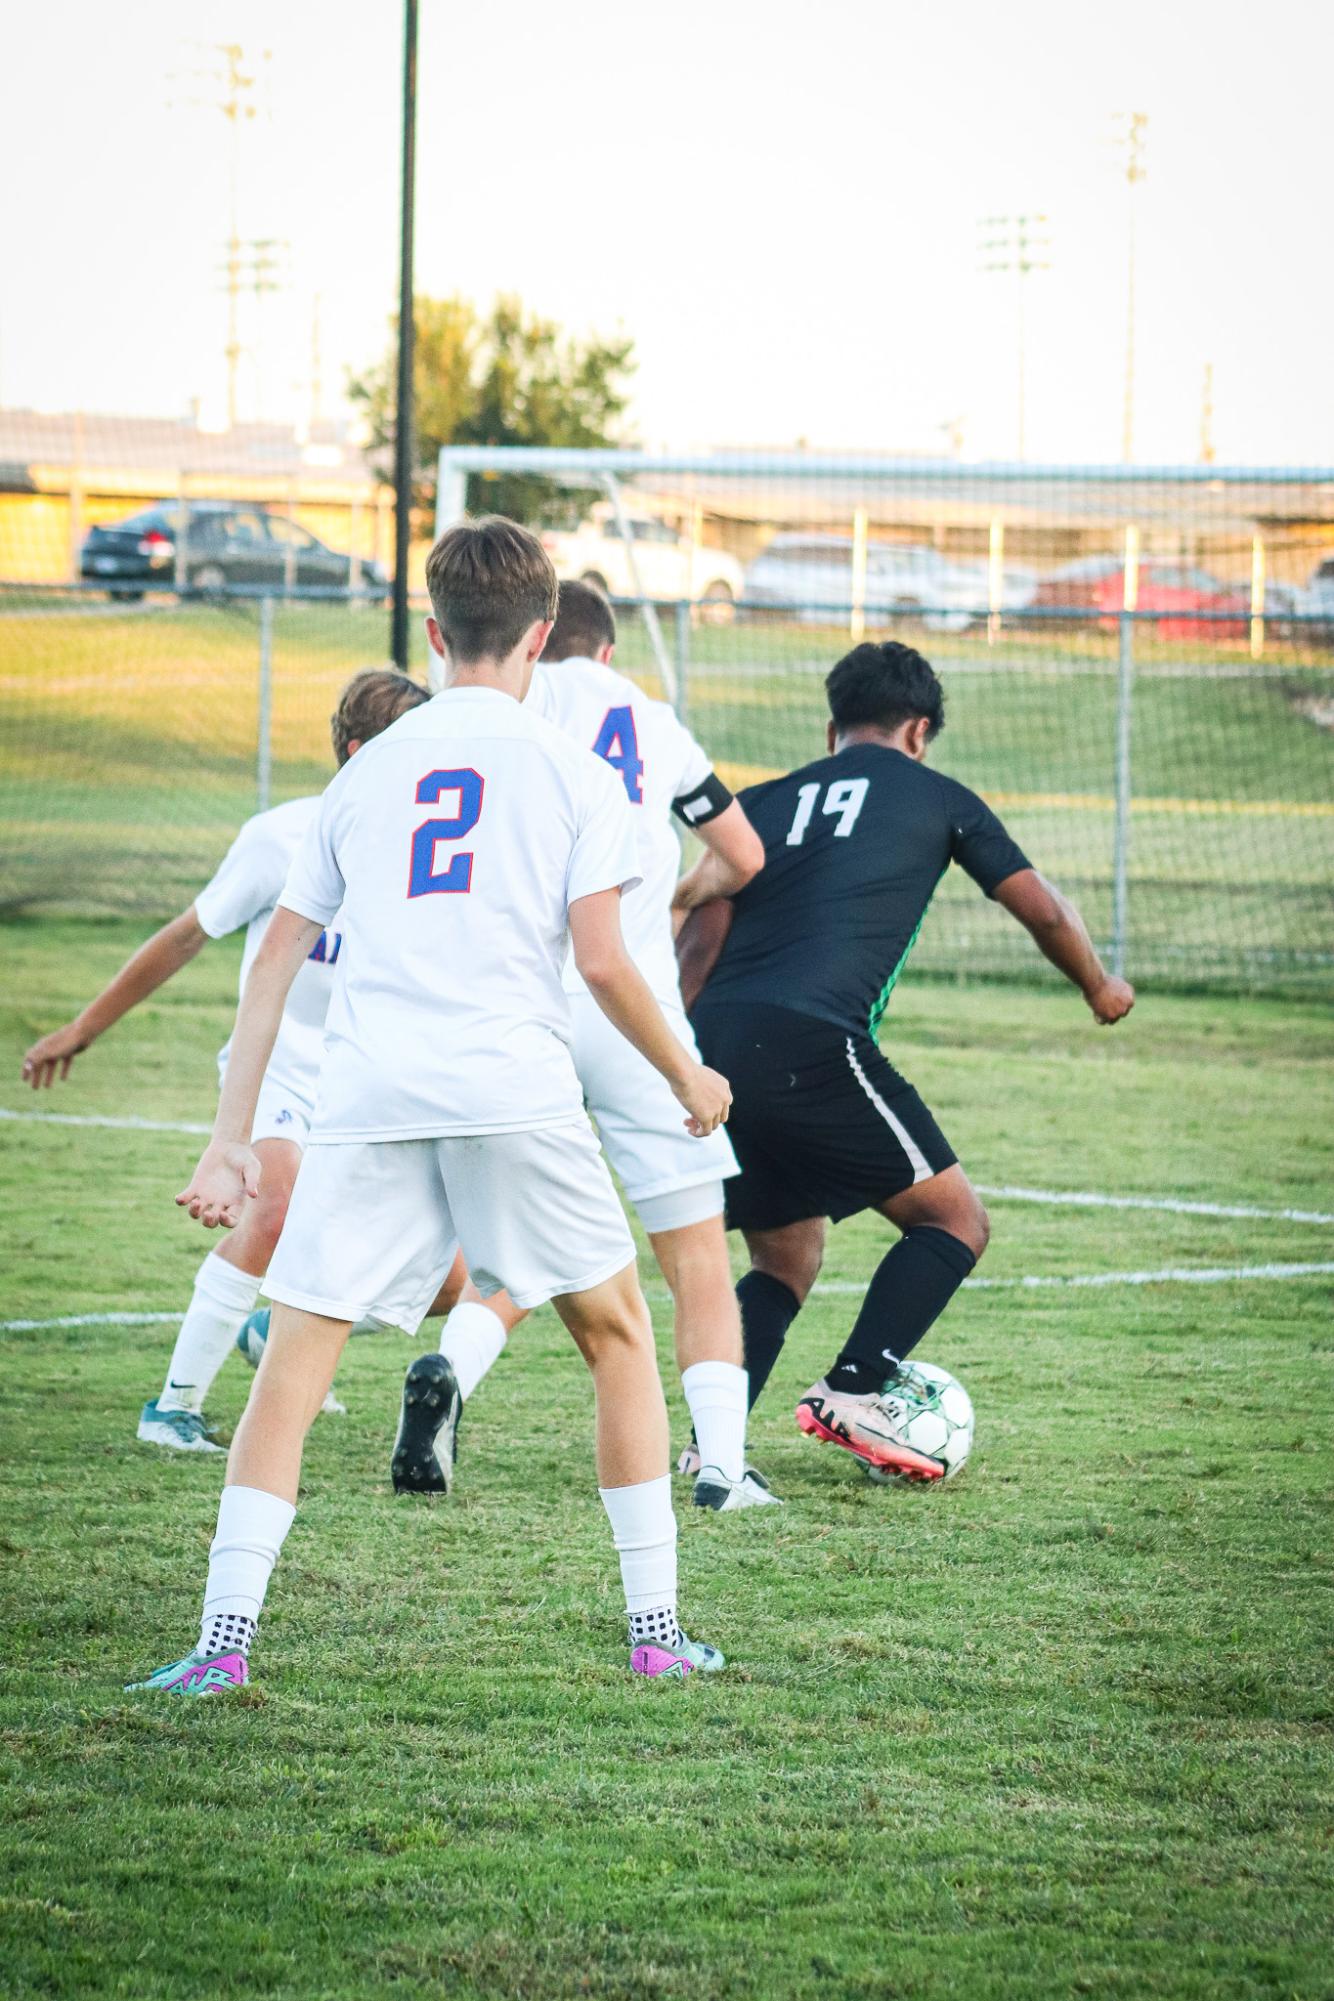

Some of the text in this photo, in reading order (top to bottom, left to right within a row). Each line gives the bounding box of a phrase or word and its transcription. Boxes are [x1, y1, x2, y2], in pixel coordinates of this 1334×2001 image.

[592, 705, 643, 804] 4
[407, 768, 484, 899] 2
[786, 778, 869, 846] 19
